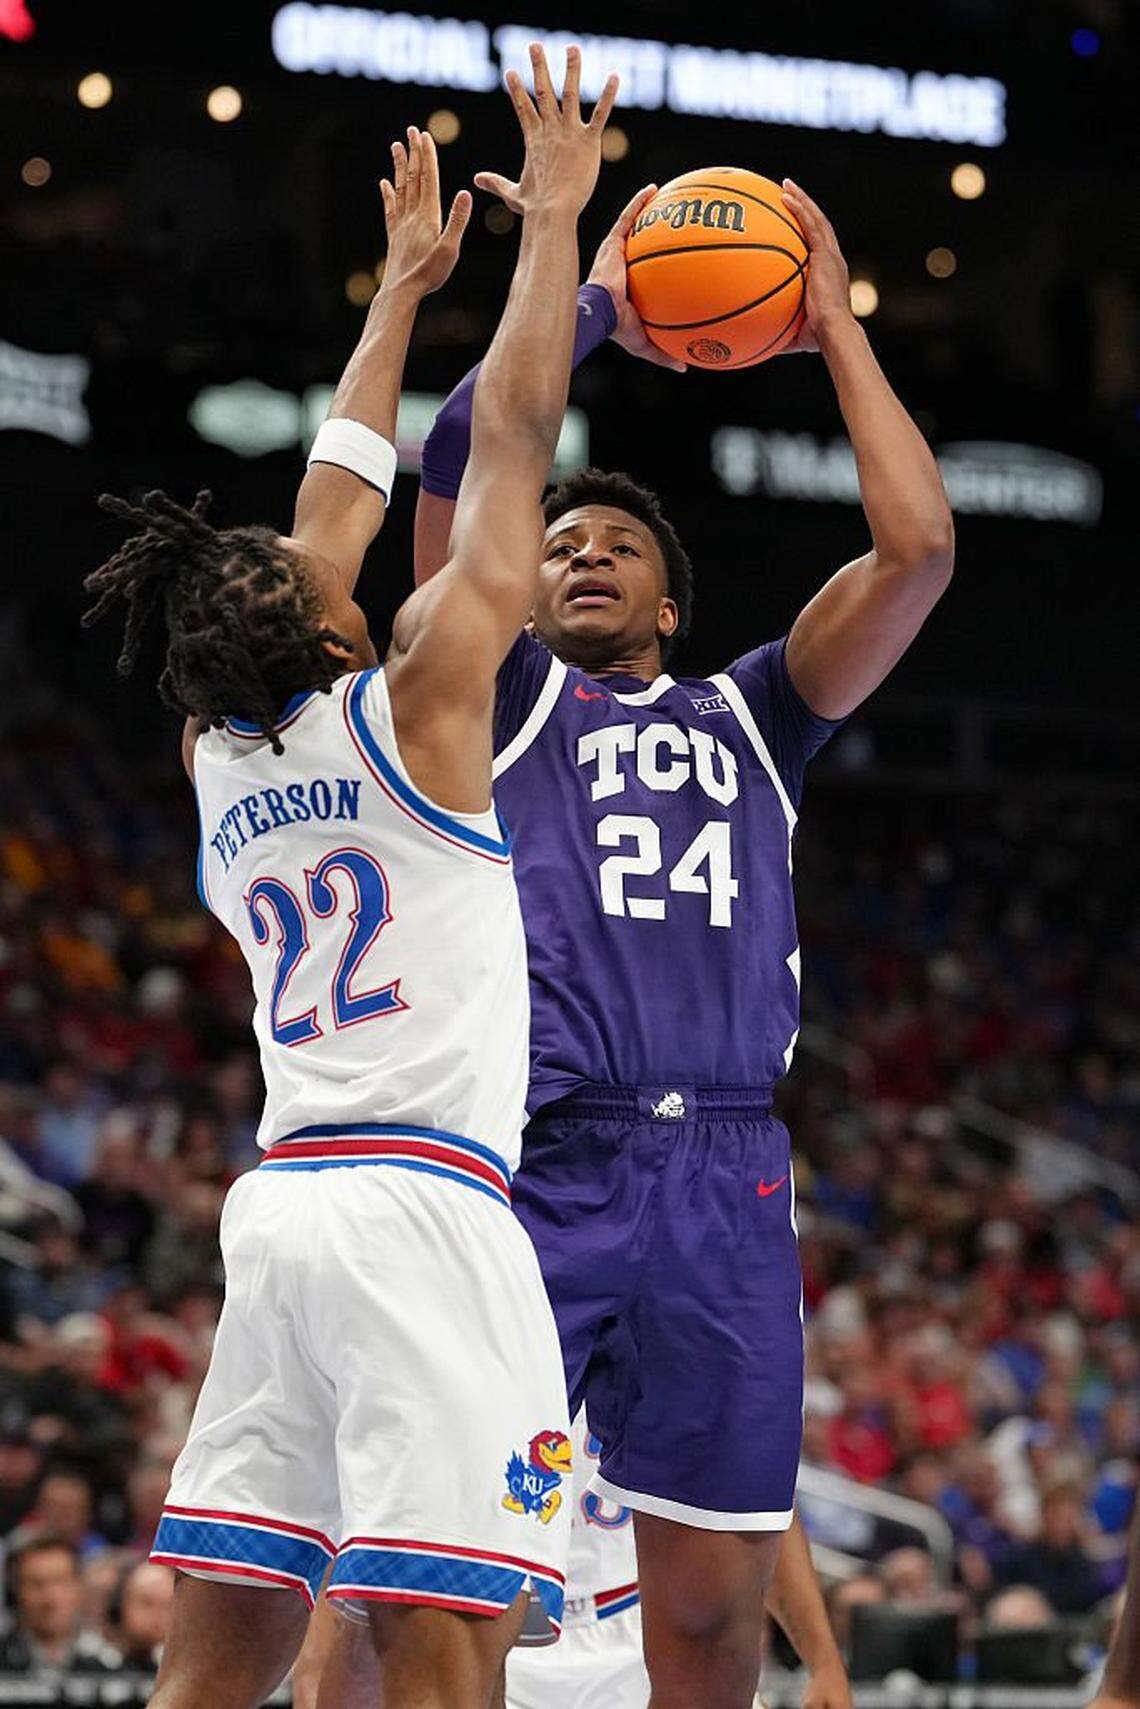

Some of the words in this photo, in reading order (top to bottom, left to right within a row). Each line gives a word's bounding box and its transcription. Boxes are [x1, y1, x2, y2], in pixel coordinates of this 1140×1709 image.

[577, 722, 739, 807] TCU
[210, 778, 362, 873] PETERSON
[596, 814, 739, 928] 24
[243, 847, 411, 1048] 22
[522, 1473, 544, 1496] KU
